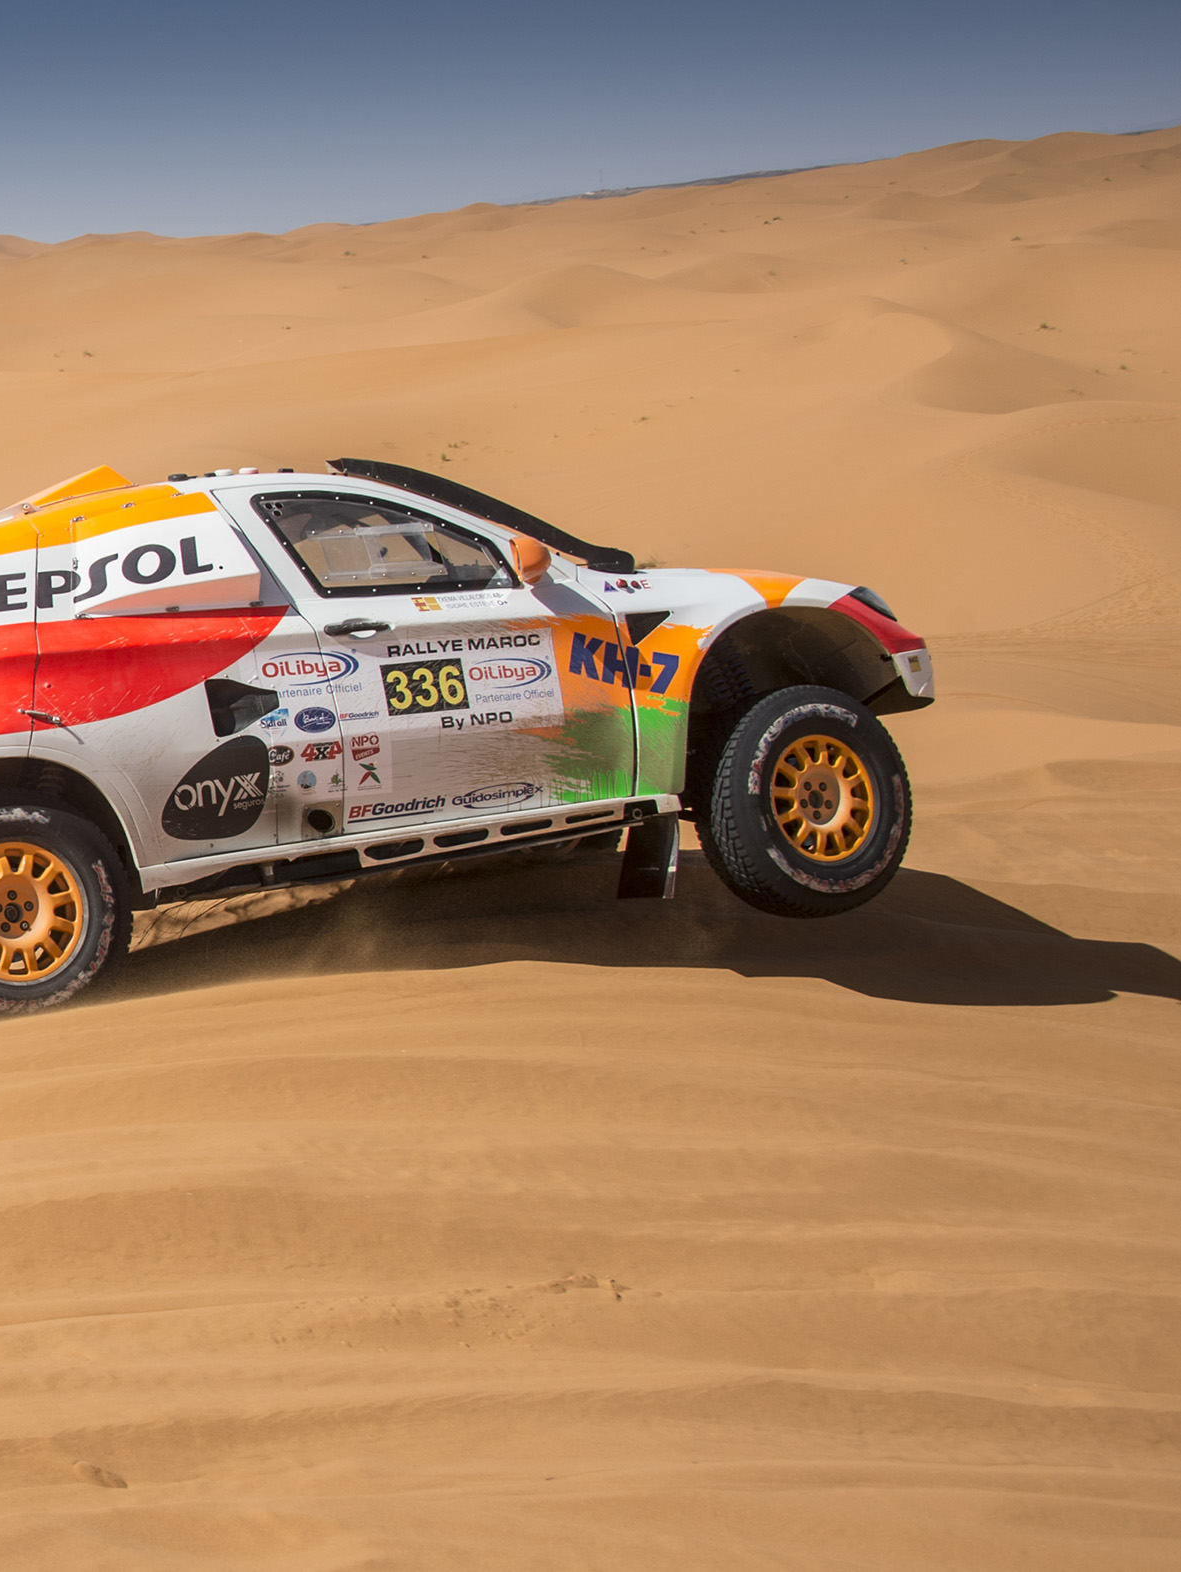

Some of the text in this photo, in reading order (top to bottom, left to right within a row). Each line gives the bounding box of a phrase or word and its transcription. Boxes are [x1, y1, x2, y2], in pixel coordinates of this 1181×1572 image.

[387, 633, 541, 658] RALLYE MAROC
[262, 660, 342, 678] OiLibya
[569, 631, 680, 694] KH-7
[469, 665, 537, 681] OiLibya
[278, 682, 363, 699] artenaire Officiel
[386, 665, 465, 710] 336
[475, 688, 555, 704] Partenaire Officiel
[340, 711, 380, 719] BFGoodrich
[440, 711, 513, 730] By NPO
[351, 734, 380, 747] NPO
[174, 772, 264, 816] onyx
[452, 785, 543, 806] Guidosimplex
[349, 796, 445, 819] BFGoodrich
